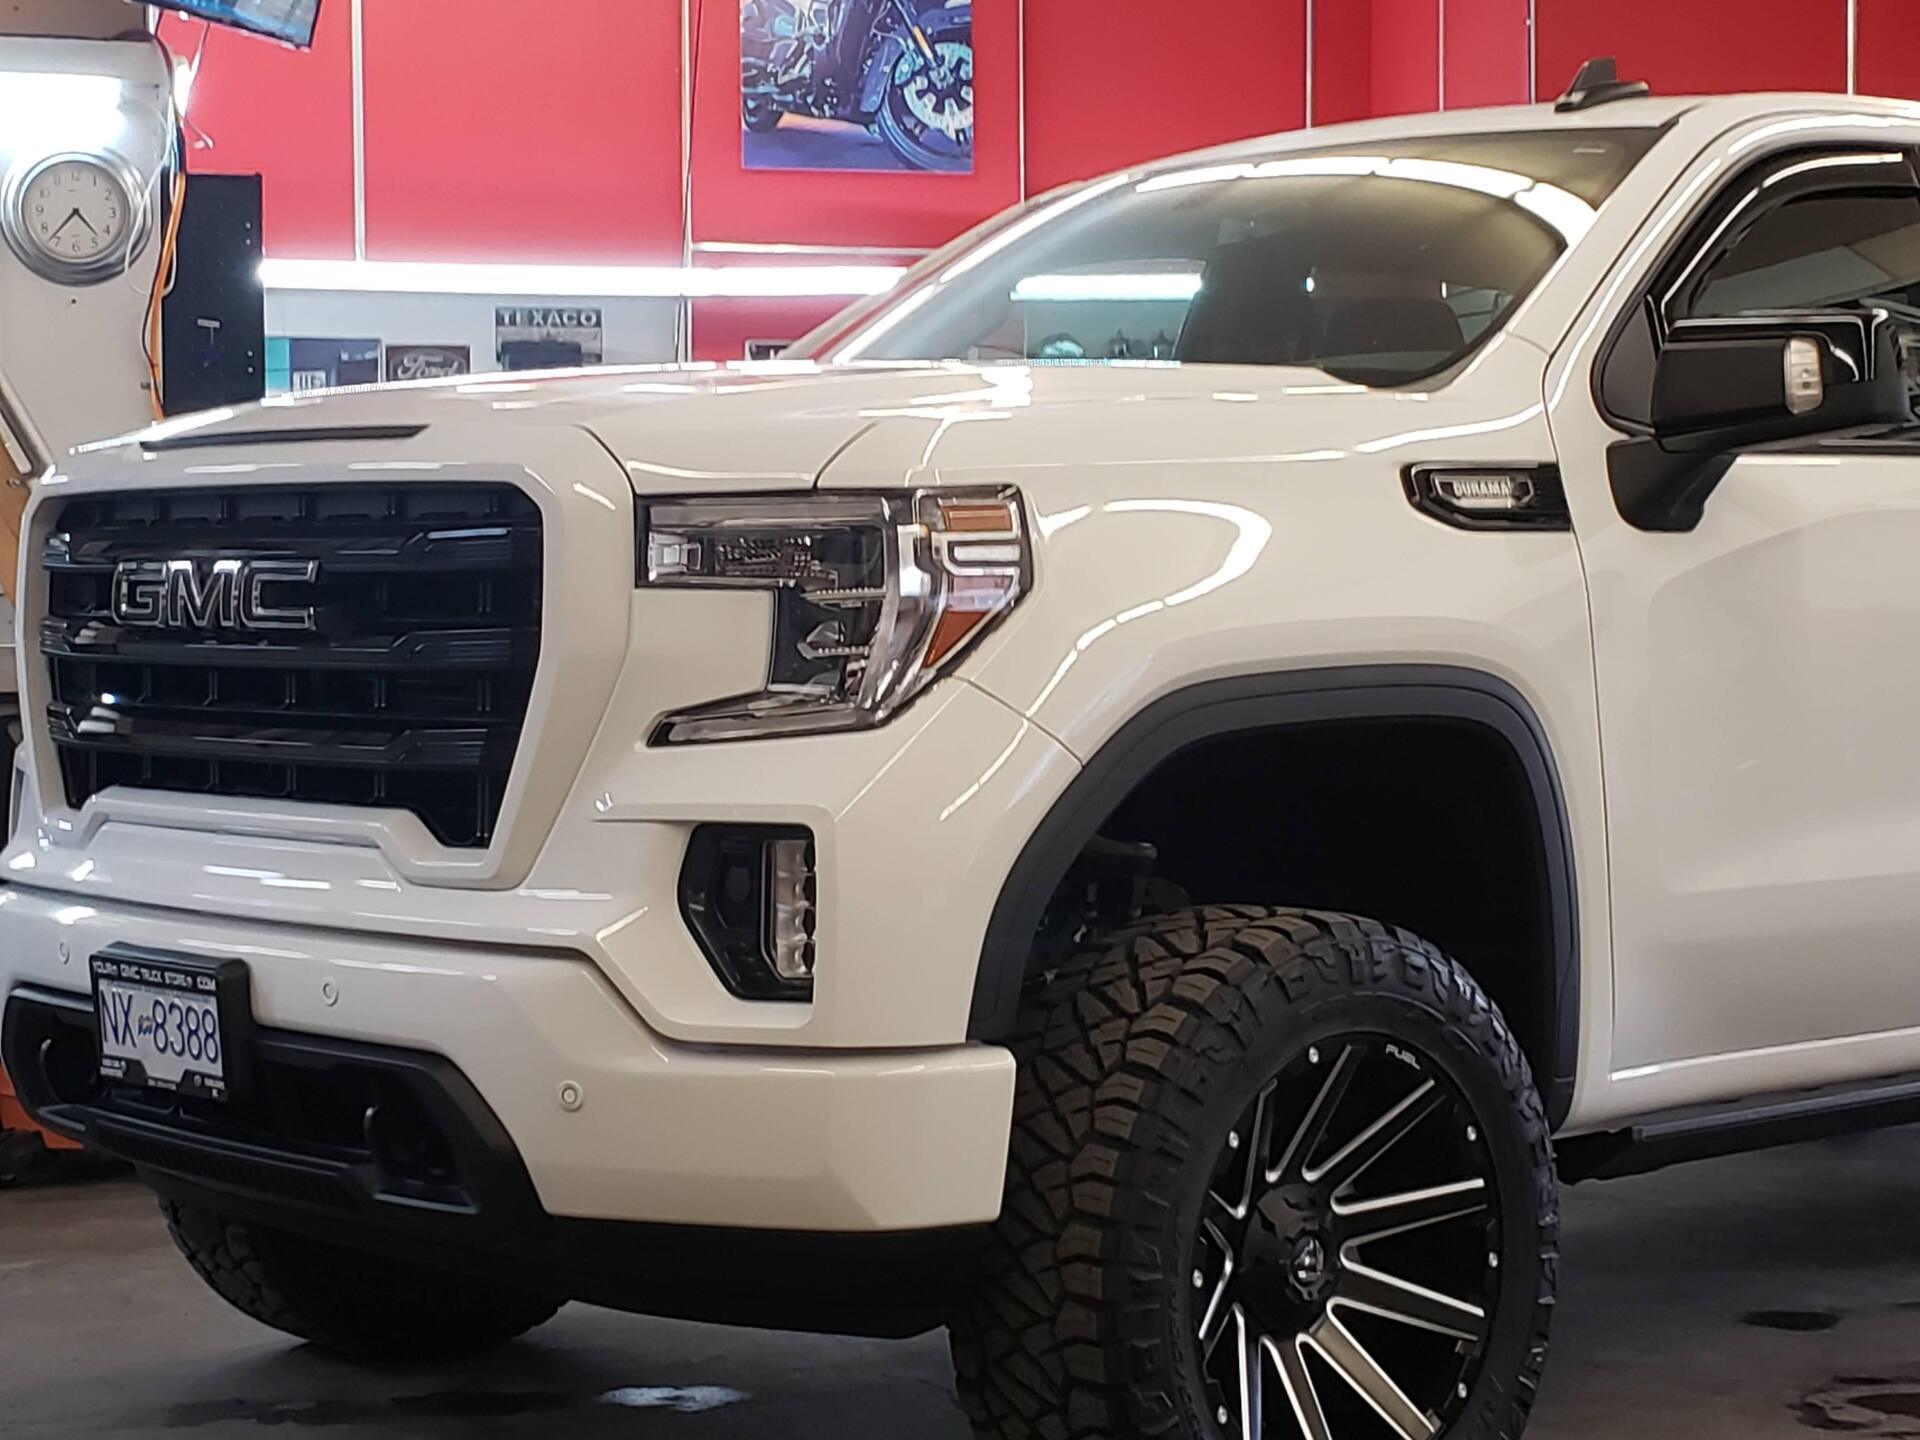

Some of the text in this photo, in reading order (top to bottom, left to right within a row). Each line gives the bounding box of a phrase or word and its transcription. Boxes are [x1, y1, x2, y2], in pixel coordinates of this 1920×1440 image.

[71, 170, 81, 182] 12
[92, 175, 97, 187] 1
[104, 189, 112, 201] 2
[36, 204, 44, 216] 9
[110, 207, 117, 219] 3
[41, 222, 49, 233] 8
[103, 224, 111, 236] 4
[54, 236, 61, 248] 7
[71, 240, 81, 252] 6
[91, 237, 99, 249] 5
[397, 354, 459, 379] Ford
[112, 560, 320, 630] GMC
[101, 988, 218, 1064] NX 8388
[1385, 1043, 1421, 1070] FUEL
